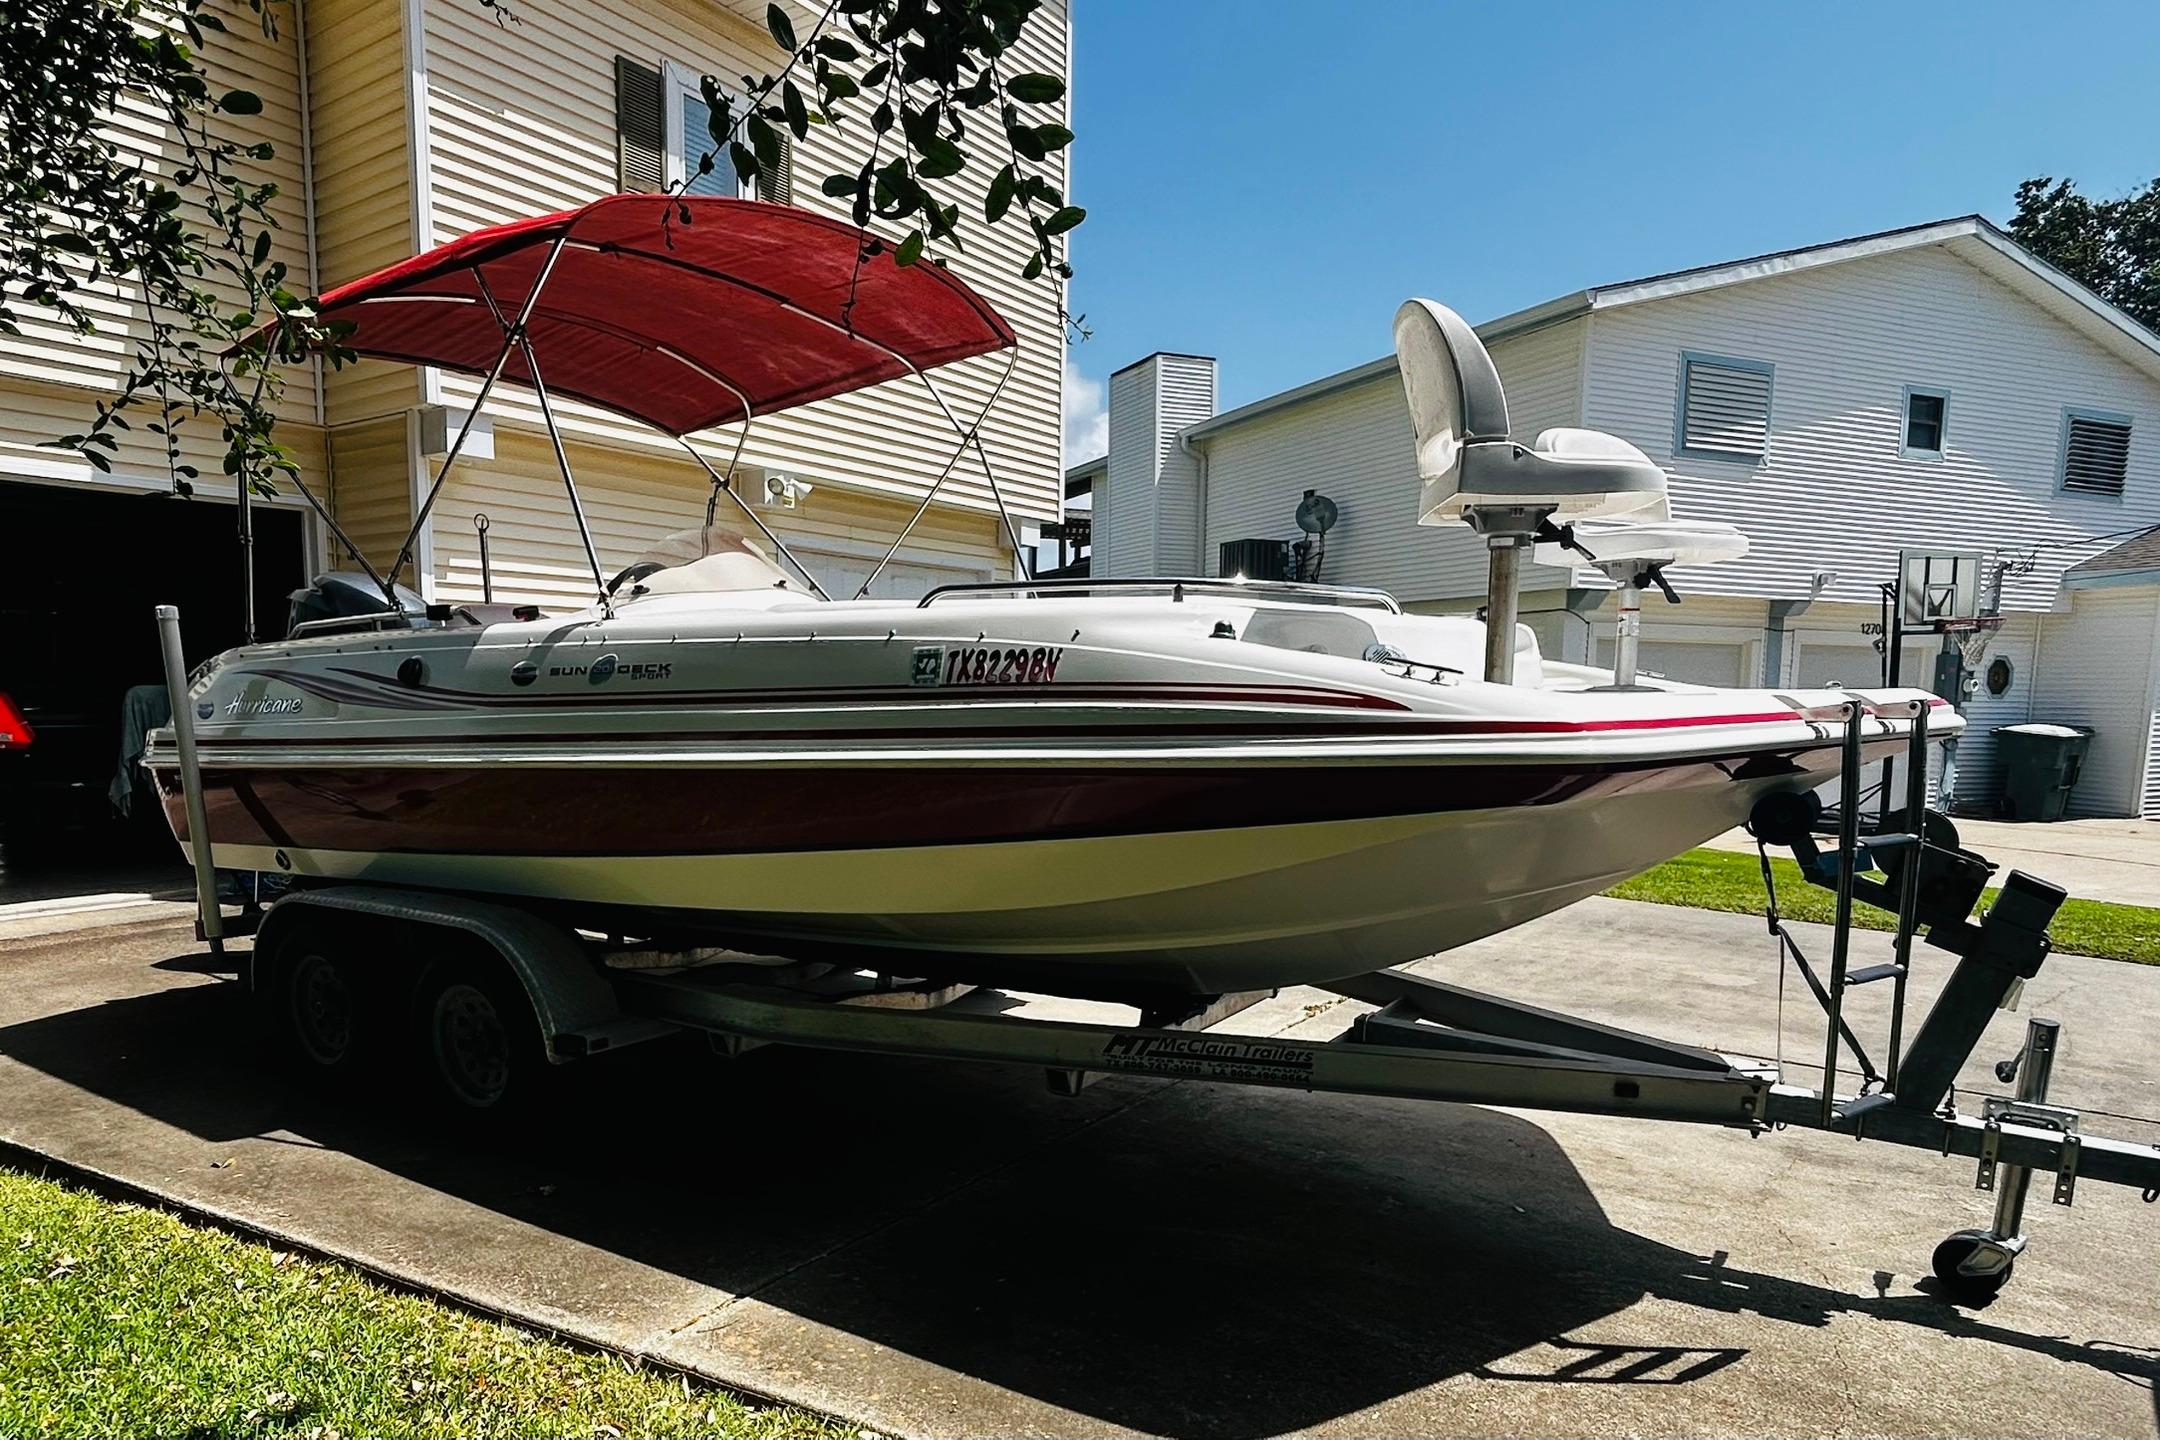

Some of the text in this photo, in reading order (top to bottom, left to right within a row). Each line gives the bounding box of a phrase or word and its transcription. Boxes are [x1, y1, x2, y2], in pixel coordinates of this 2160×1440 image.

[549, 666, 588, 677] SUN
[617, 663, 673, 674] DECK
[631, 672, 671, 680] SPORT
[224, 691, 303, 716] Hurricane
[1156, 1036, 1237, 1056] McClain
[1243, 1043, 1314, 1062] Trailers
